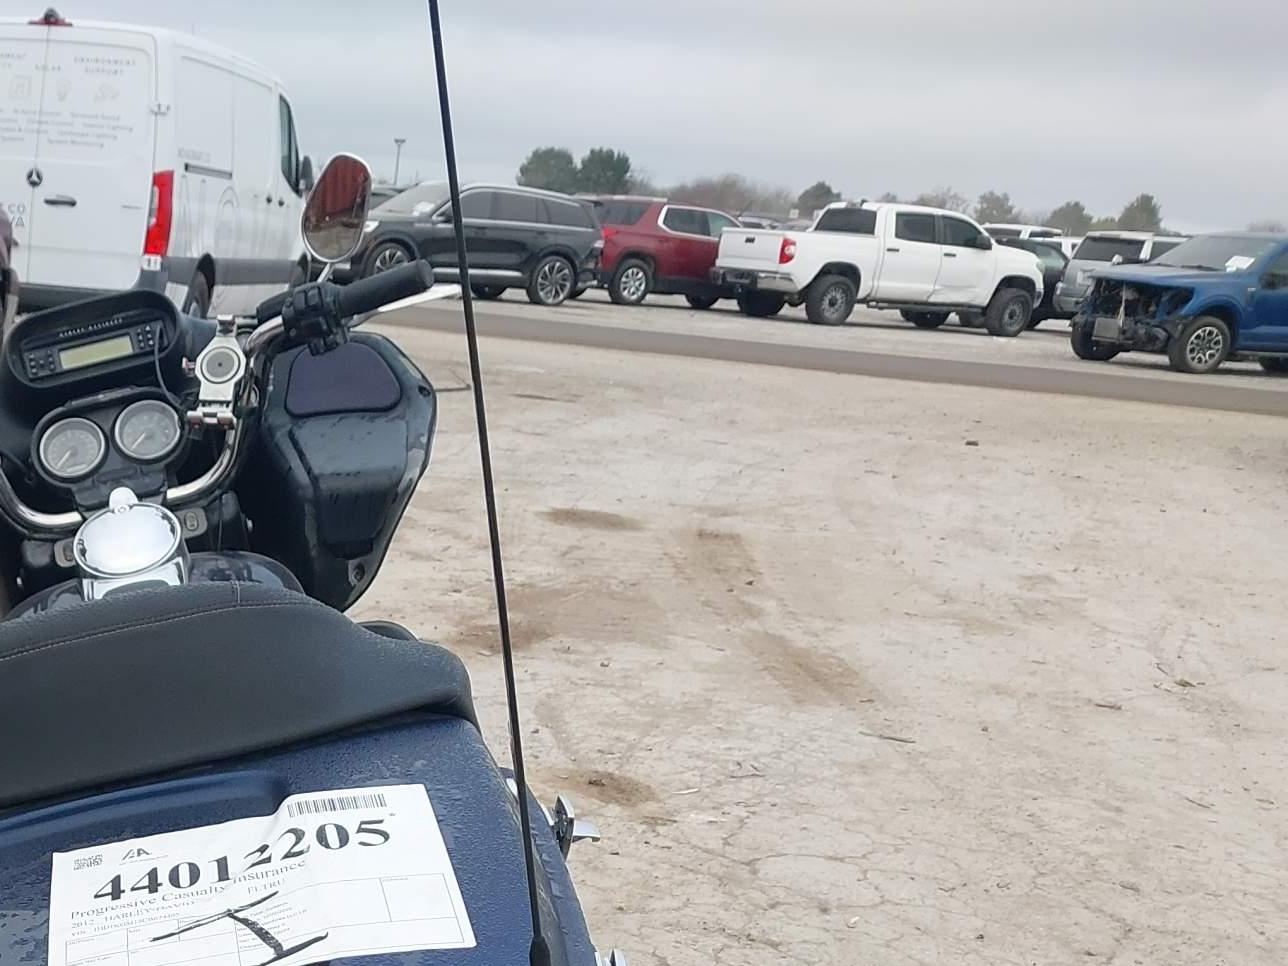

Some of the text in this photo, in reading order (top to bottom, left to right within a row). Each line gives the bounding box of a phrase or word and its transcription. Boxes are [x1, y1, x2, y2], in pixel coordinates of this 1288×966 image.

[70, 859, 307, 921] Progressive Casualty Insurance
[93, 818, 391, 902] 44012205
[70, 918, 95, 930] 2012
